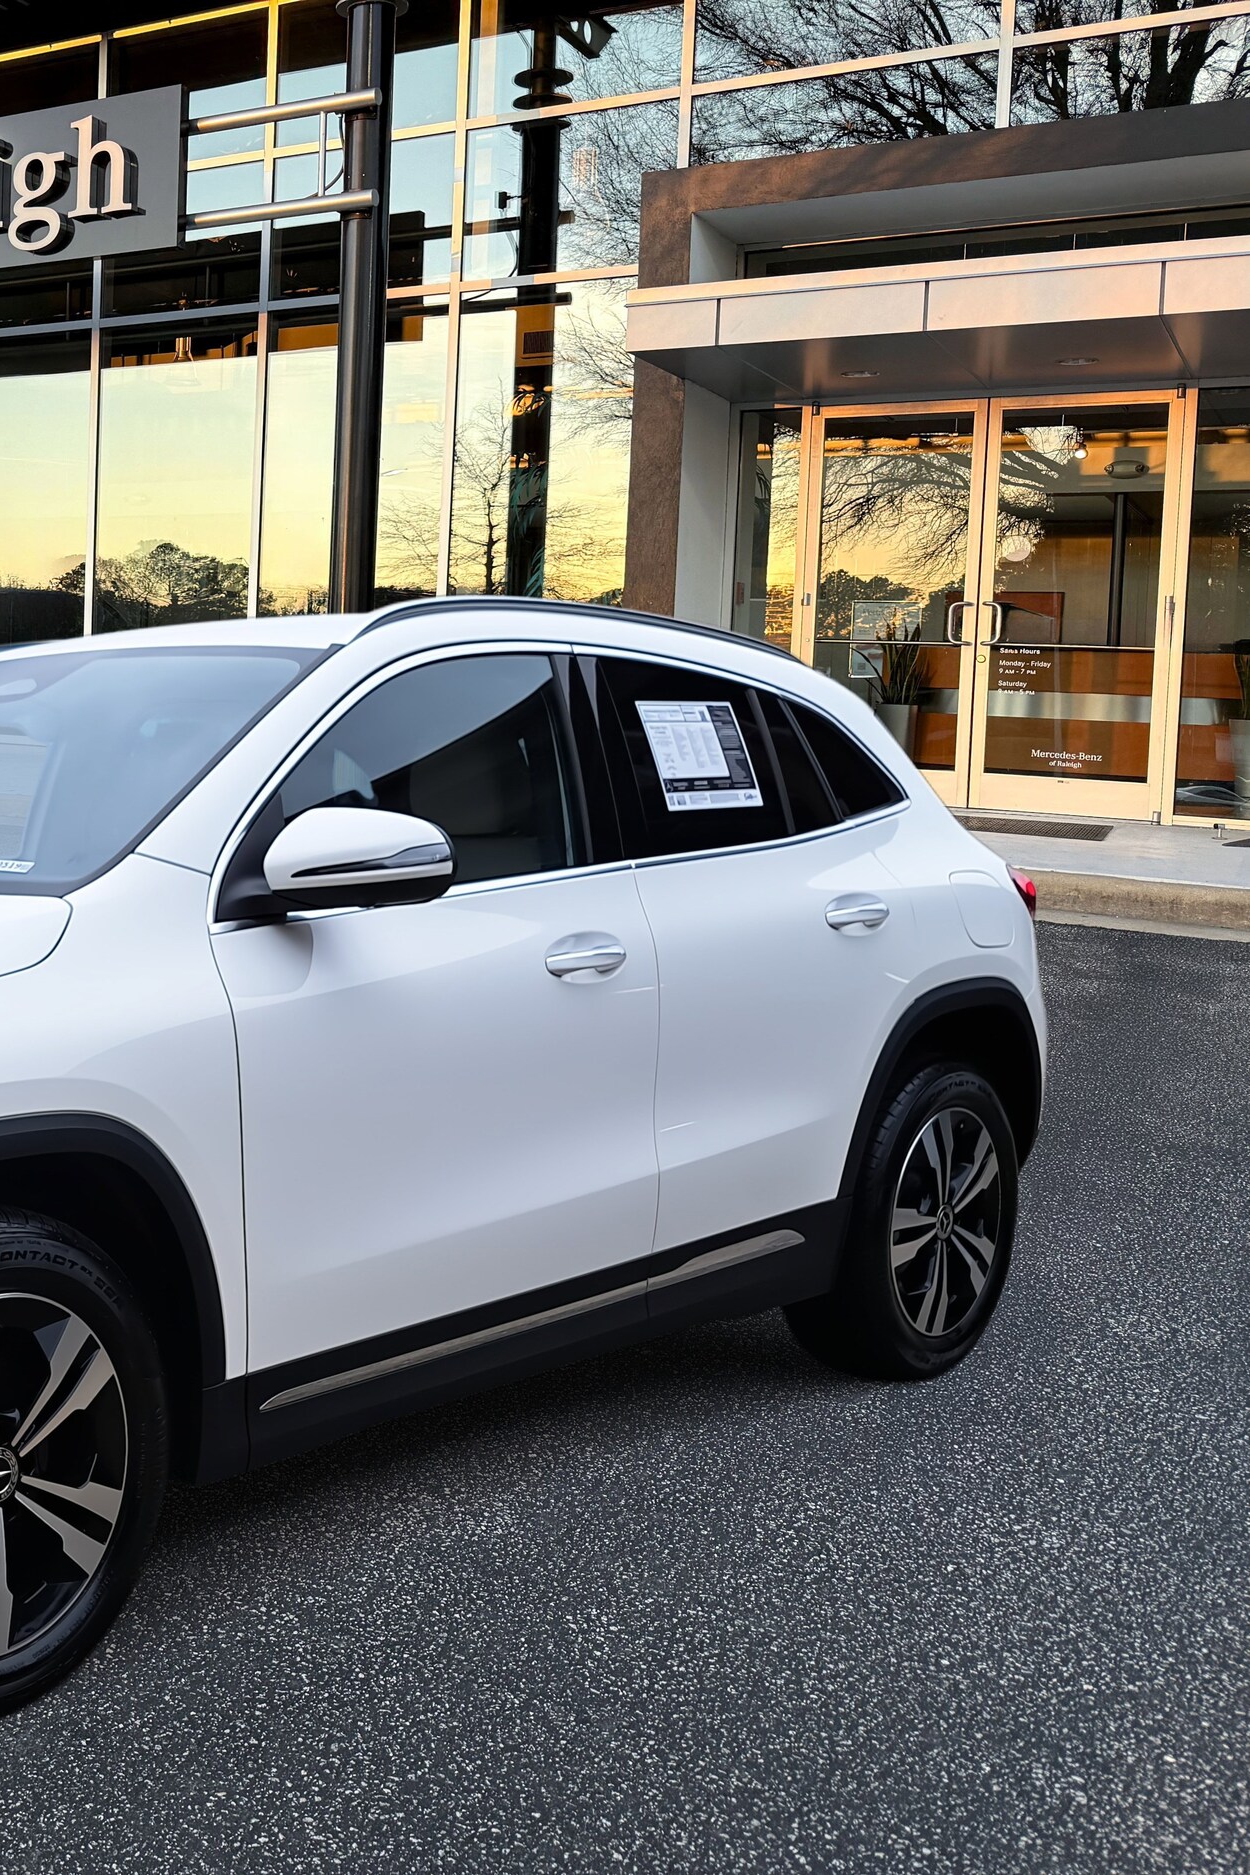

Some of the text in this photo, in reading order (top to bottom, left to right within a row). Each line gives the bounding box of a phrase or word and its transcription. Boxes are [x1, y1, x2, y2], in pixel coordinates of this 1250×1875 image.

[998, 680, 1027, 688] Saturday
[1031, 749, 1102, 761] Mercedes-Benz
[1057, 761, 1082, 769] Raleigh
